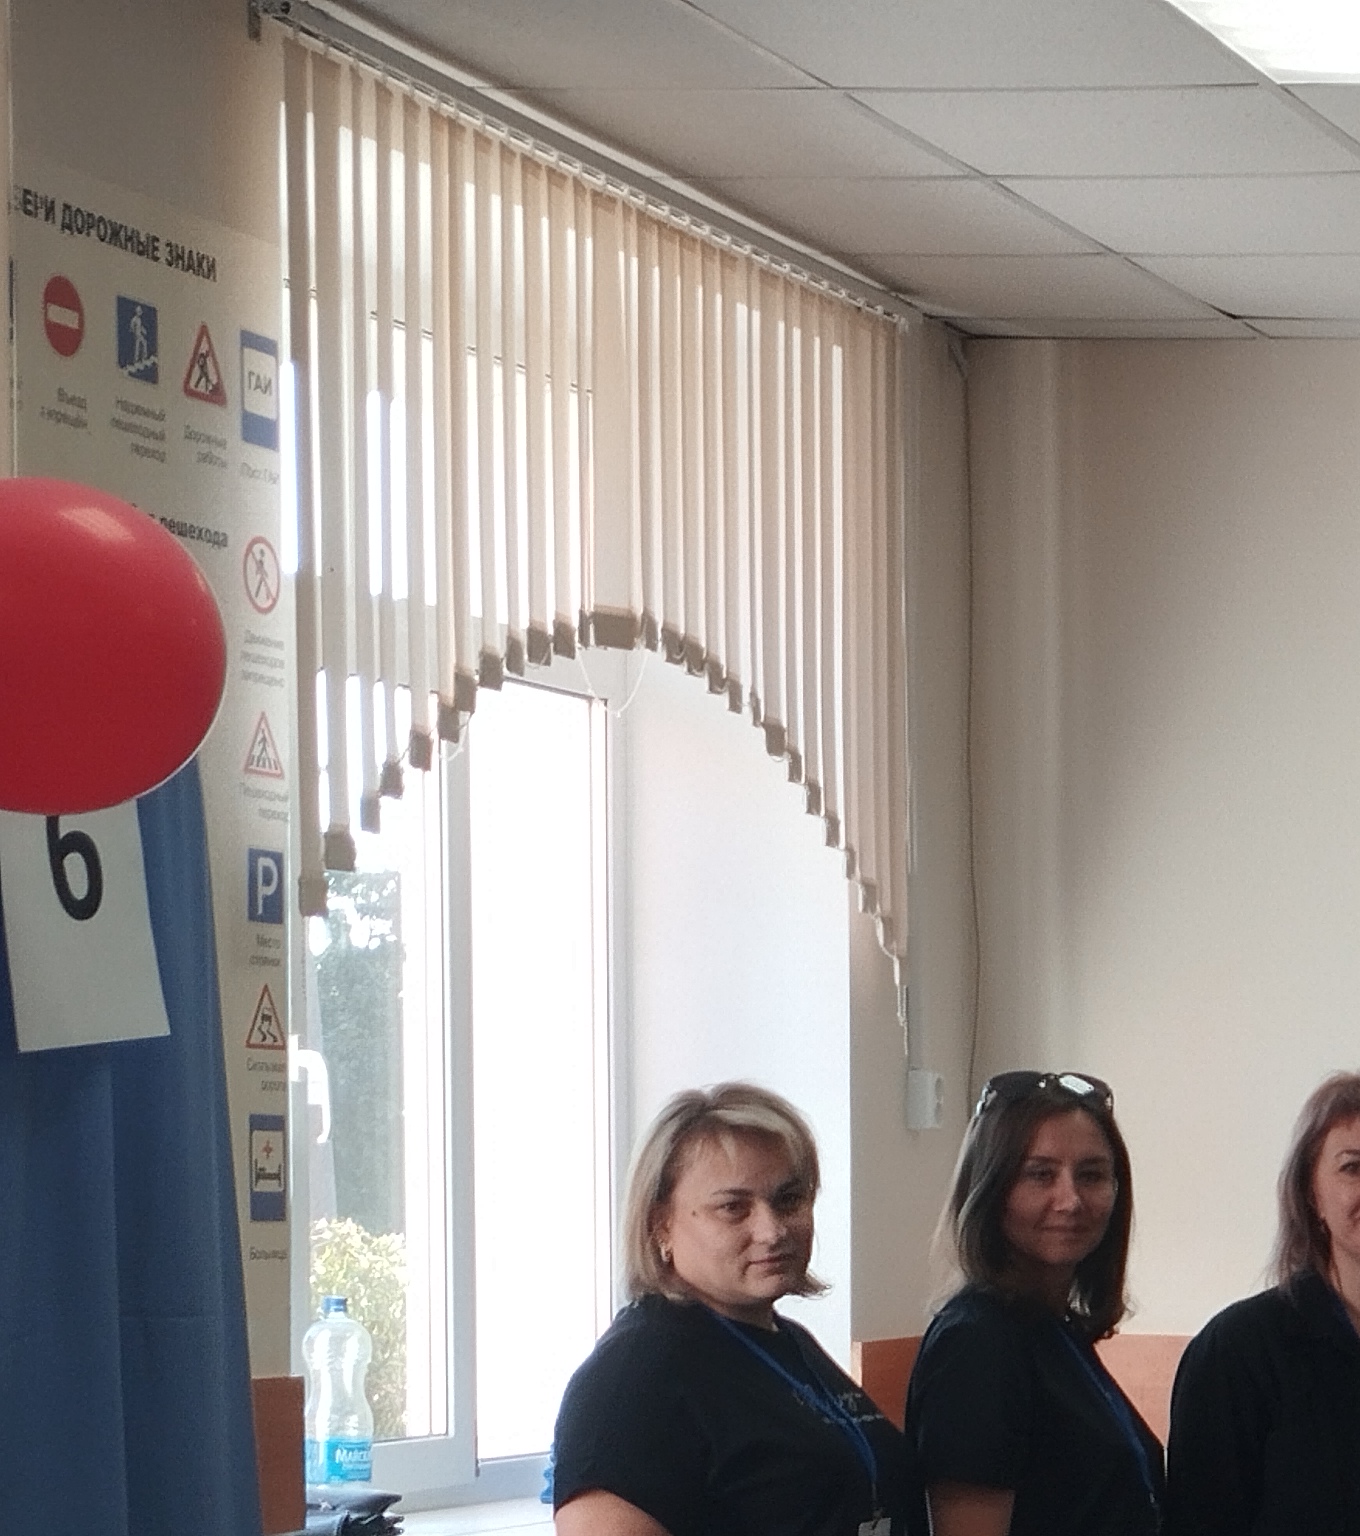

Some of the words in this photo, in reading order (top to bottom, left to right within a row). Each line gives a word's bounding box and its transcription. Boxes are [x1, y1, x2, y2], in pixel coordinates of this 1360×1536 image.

[60, 202, 160, 264] ДОРОЖНЫЕ
[164, 239, 217, 282] ЗНАКИ
[247, 369, 273, 397] ГАИ
[45, 814, 103, 921] 6
